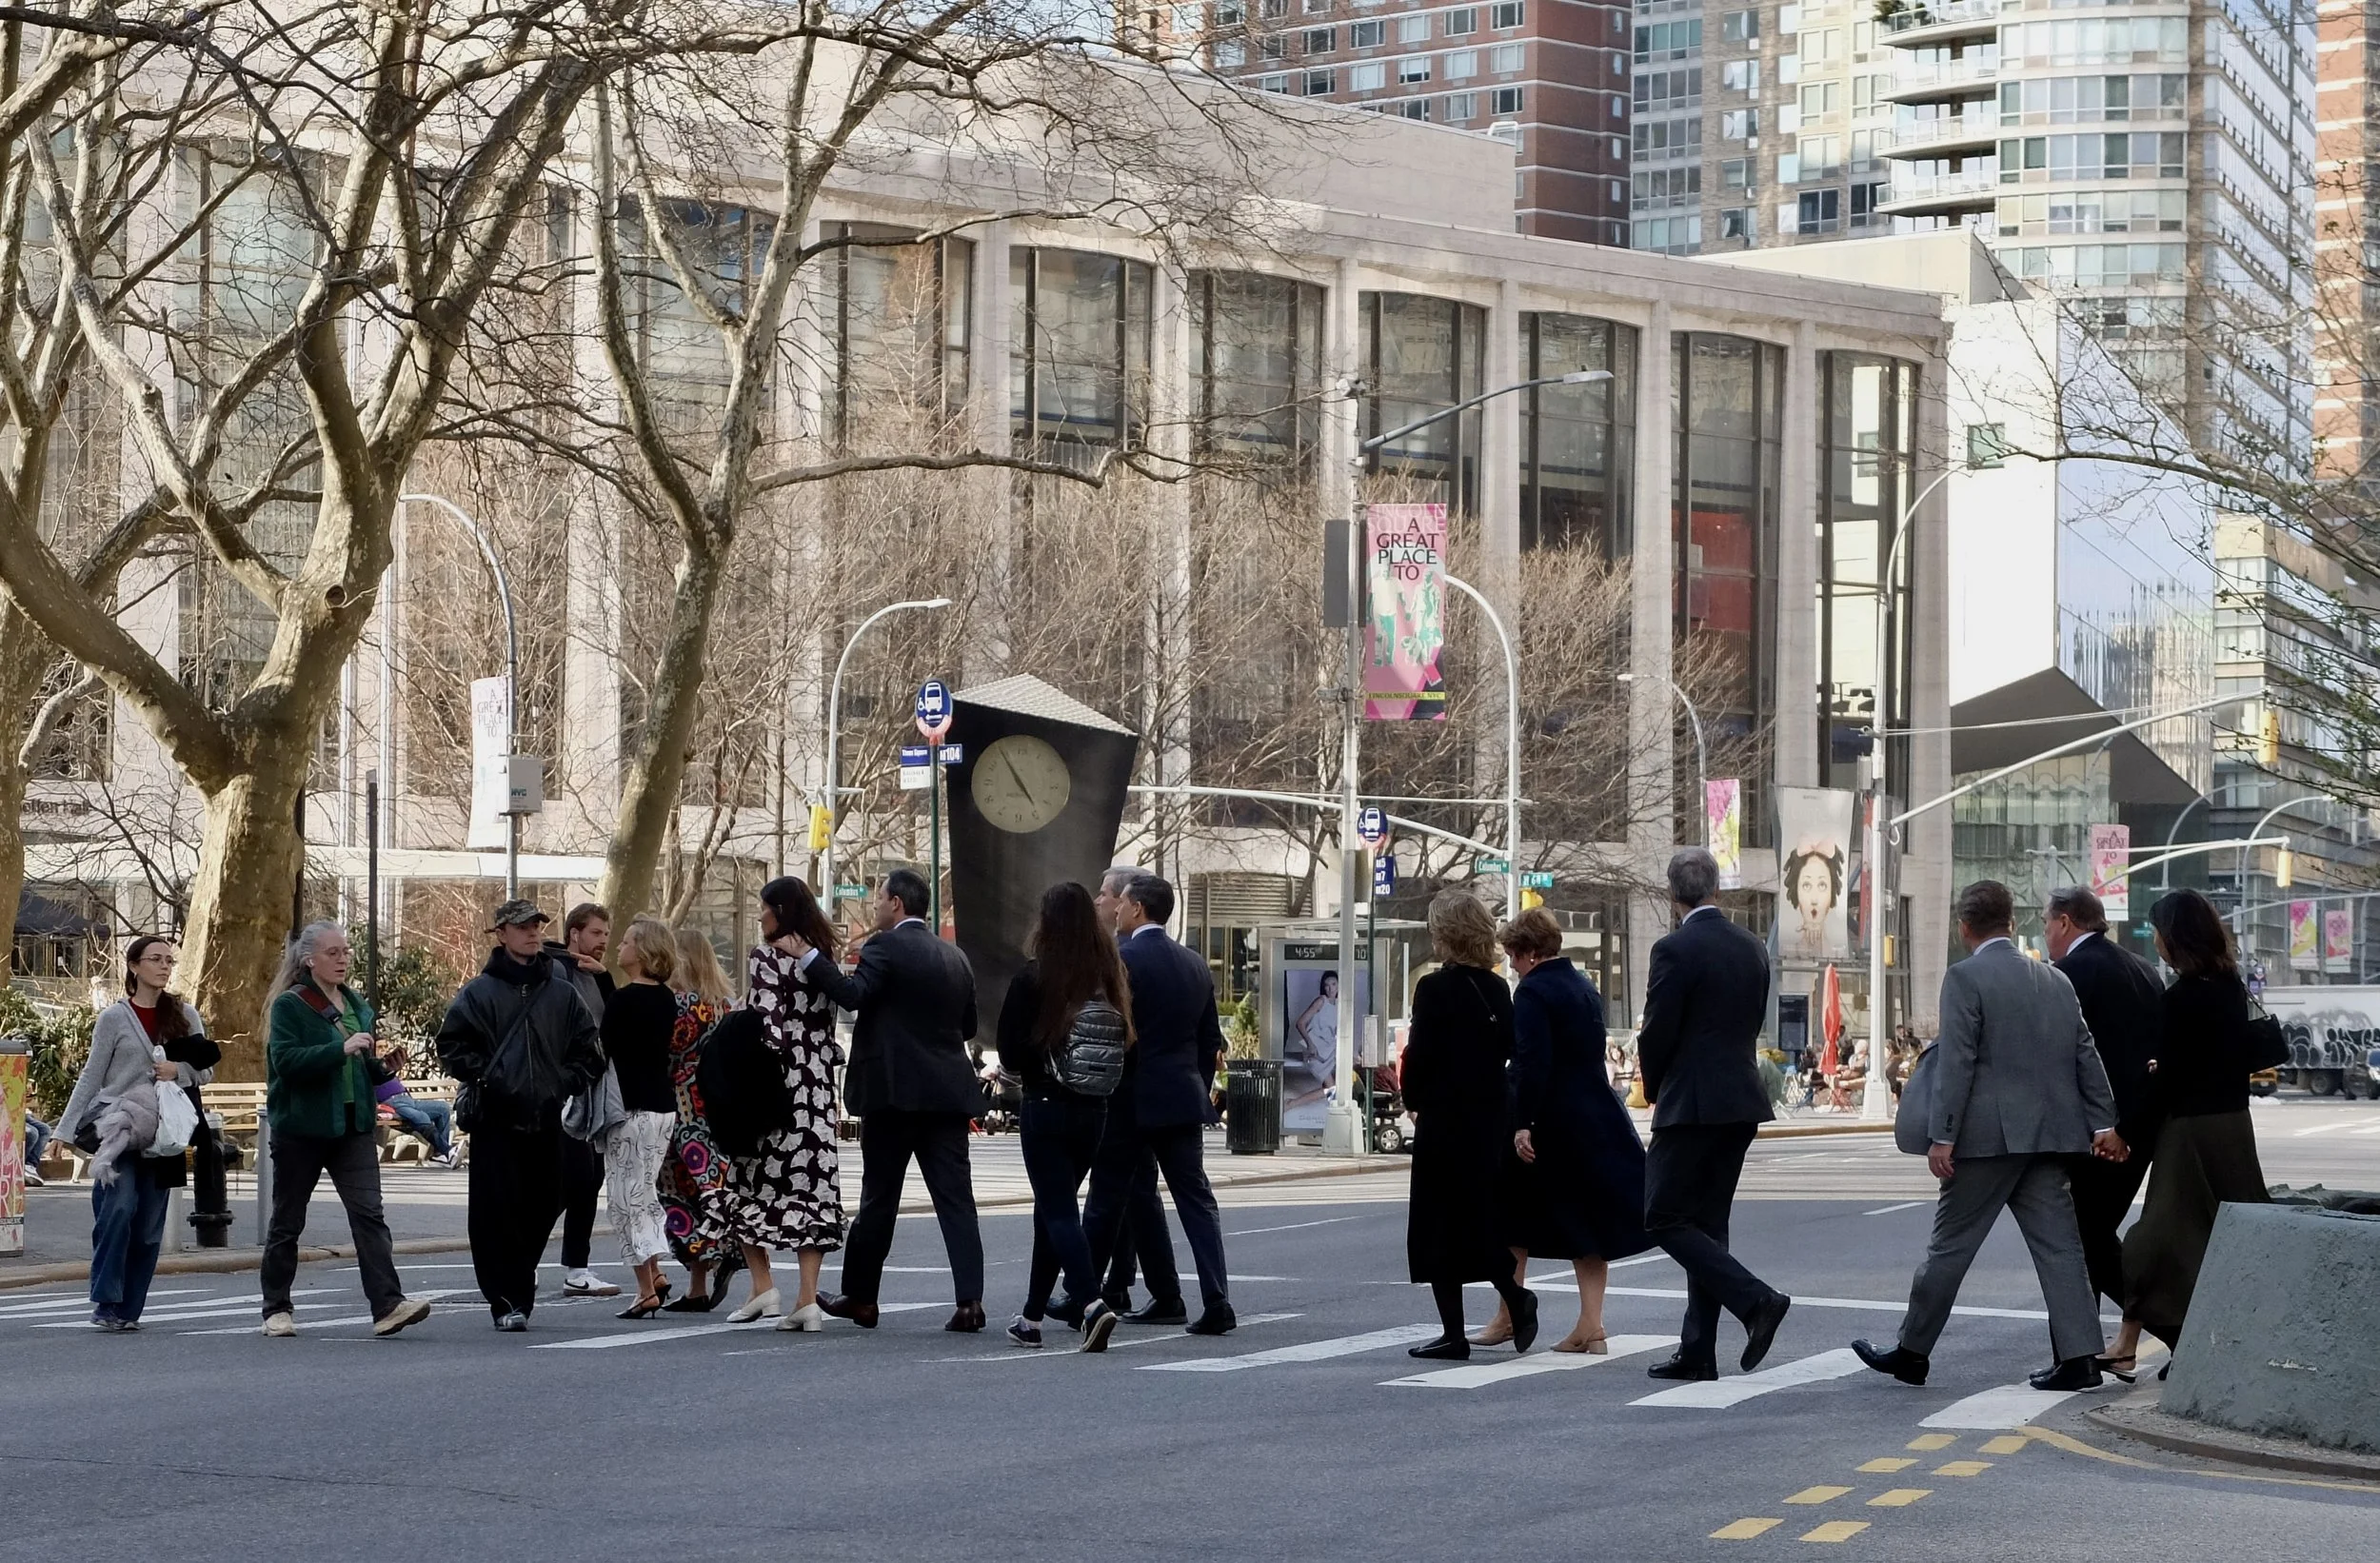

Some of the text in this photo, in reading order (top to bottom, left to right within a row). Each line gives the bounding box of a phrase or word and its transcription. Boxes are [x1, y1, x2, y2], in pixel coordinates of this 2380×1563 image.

[1407, 518, 1420, 532] A
[1377, 533, 1439, 549] GREAT
[1378, 549, 1437, 564] PLACE
[1394, 565, 1418, 581] TO
[489, 689, 497, 699] A
[478, 713, 504, 725] PLACE
[486, 725, 497, 738] TO
[940, 746, 960, 762] M104
[510, 788, 527, 797] NYC
[23, 799, 57, 813] effen
[1478, 861, 1502, 872] Columbus
